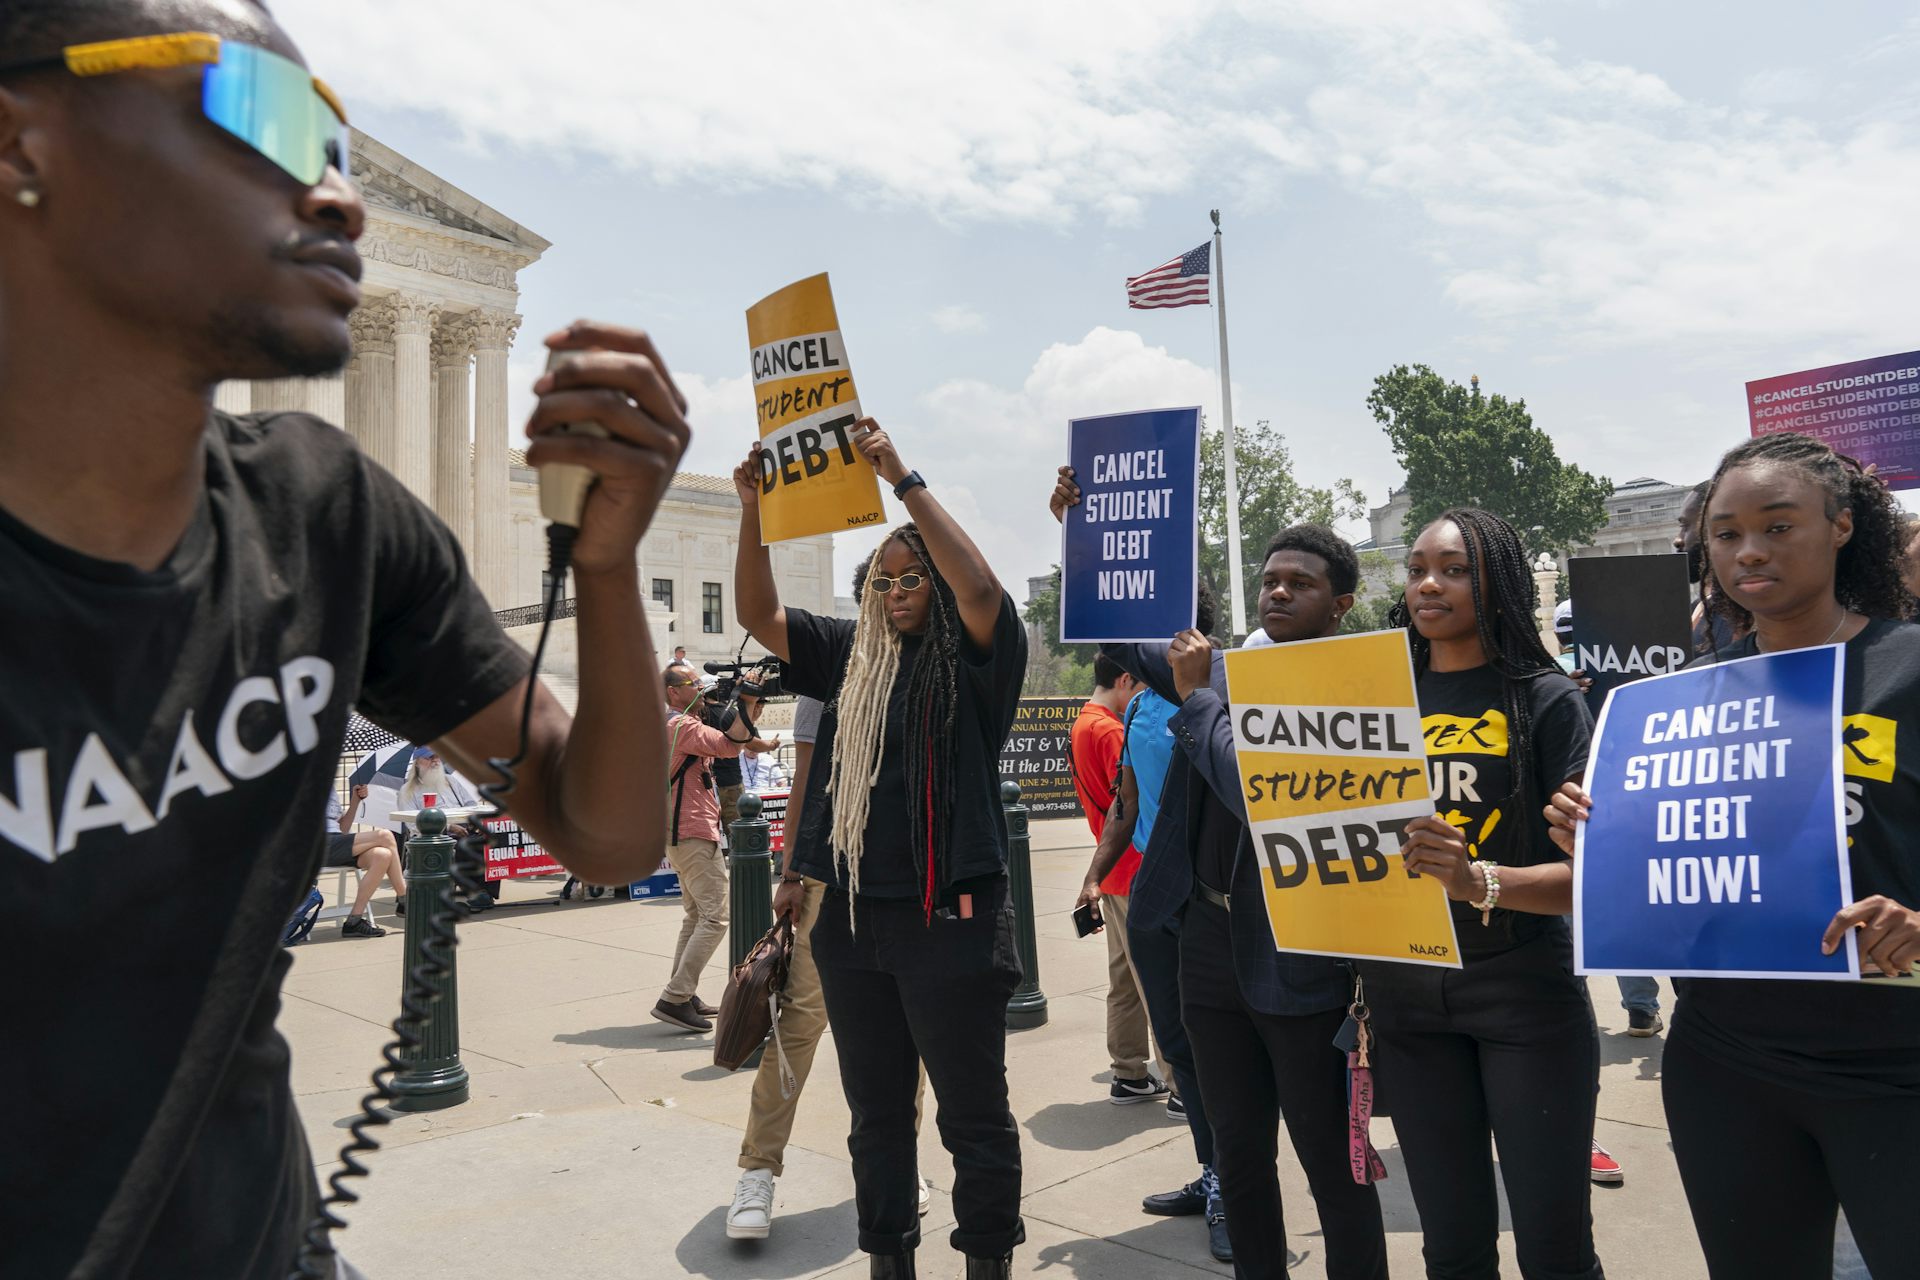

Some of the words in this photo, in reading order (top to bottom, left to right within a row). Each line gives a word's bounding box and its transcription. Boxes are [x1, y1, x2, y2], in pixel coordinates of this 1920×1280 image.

[754, 337, 839, 379] CANCEL
[757, 376, 850, 425] STUDENT
[1754, 367, 1920, 405] #CANCELSTUDENTDEB
[1755, 383, 1920, 419] #CANCELSTUDENTDEB
[760, 413, 856, 496] DEBT
[1093, 449, 1167, 484] CANCEL
[847, 512, 879, 526] NAACP
[1086, 488, 1173, 523] STUDENT
[1102, 530, 1152, 561] DEBT
[1098, 569, 1155, 601] NOW!
[1579, 643, 1685, 676] NAACP
[1038, 707, 1063, 719] FOR
[1643, 695, 1780, 745] CANCEL
[1000, 738, 1035, 753] AST
[1038, 737, 1051, 752] &
[1055, 737, 1067, 751] V
[1241, 708, 1410, 752] CANCEL
[1018, 759, 1040, 773] the
[1624, 738, 1792, 791] STUDENT
[1019, 778, 1040, 787] JUNE
[1040, 778, 1049, 787] 29
[1054, 777, 1072, 787] JULY
[1034, 791, 1061, 801] program
[1247, 766, 1421, 802] STUDENT
[487, 820, 517, 833] DEATH
[761, 811, 777, 820] THE
[1656, 795, 1752, 842] DEBT
[488, 846, 519, 861] EQUAL
[508, 833, 519, 845] IS
[488, 868, 509, 878] ACTION
[1647, 855, 1762, 904] NOW!
[1409, 943, 1449, 957] NAACP
[1352, 1145, 1364, 1181] Alpha
